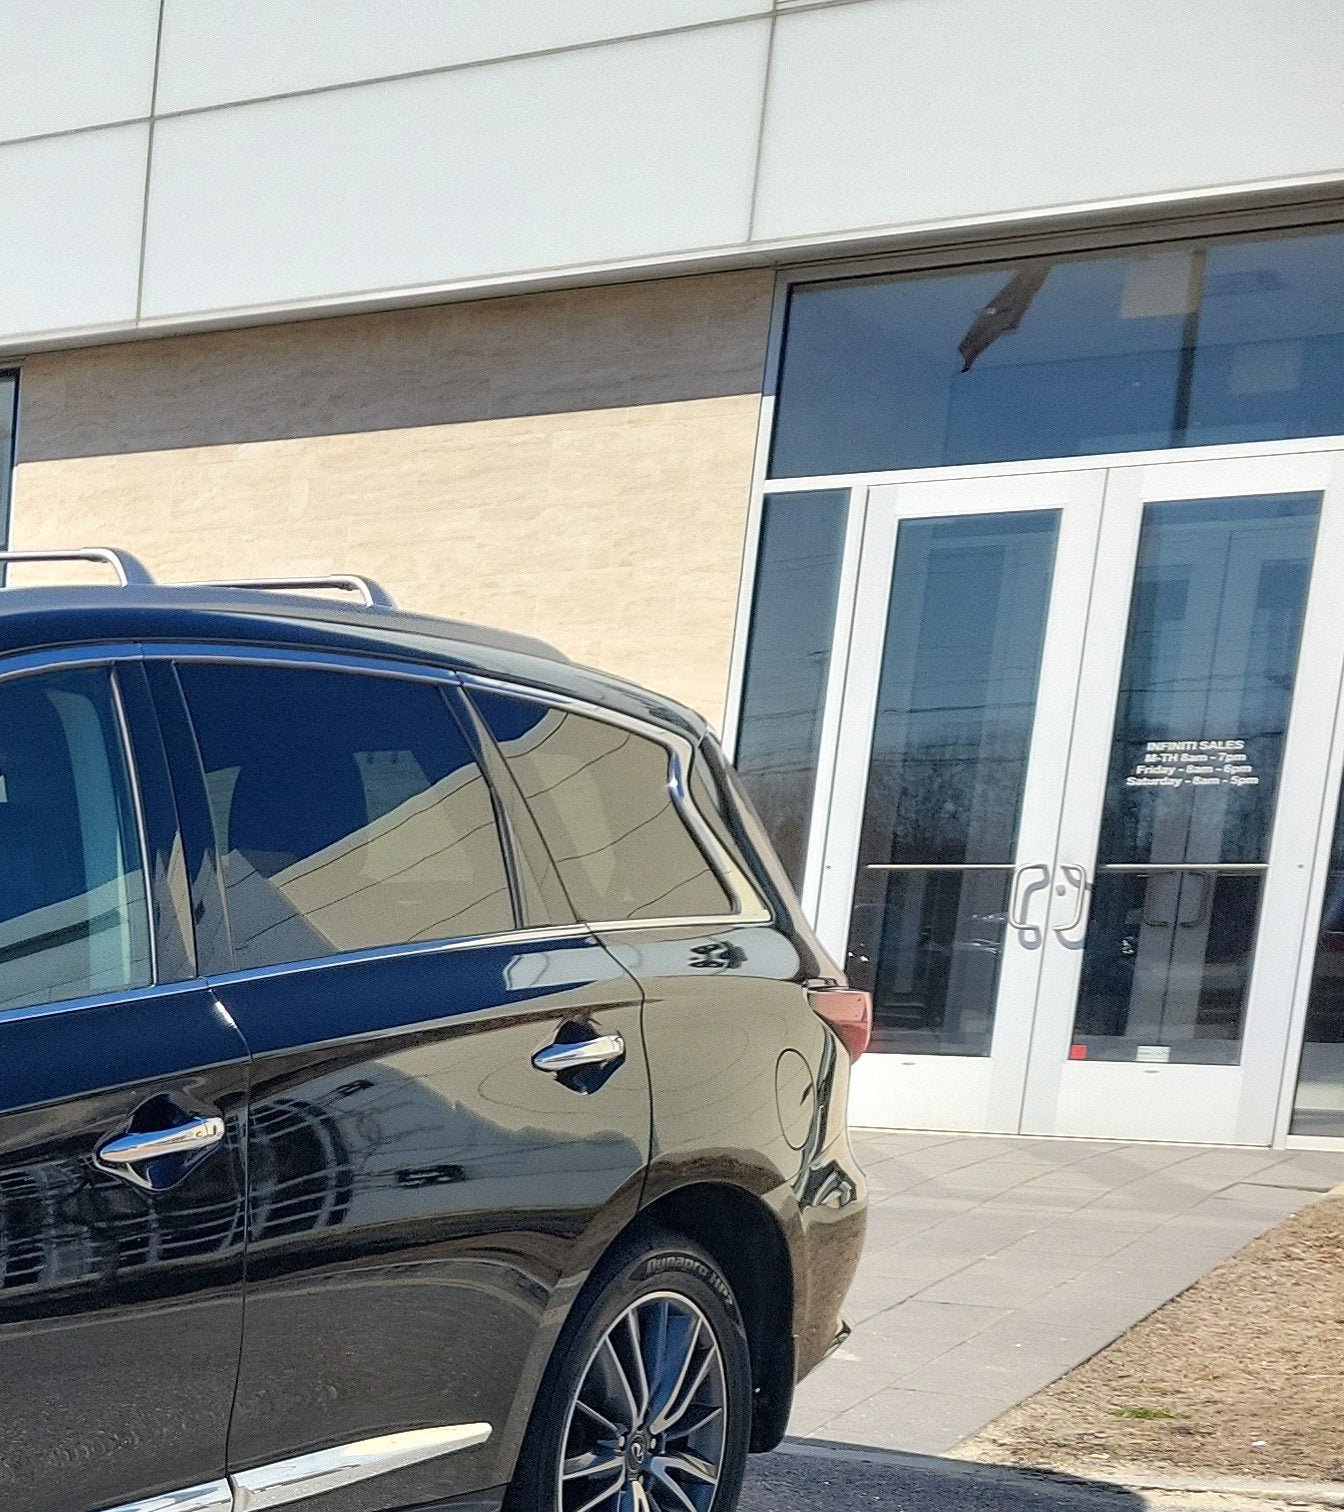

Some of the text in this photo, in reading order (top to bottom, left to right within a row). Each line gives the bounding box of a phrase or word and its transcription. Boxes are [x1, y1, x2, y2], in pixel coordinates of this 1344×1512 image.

[1146, 740, 1245, 751] INFINITI SALES
[1217, 752, 1247, 763] 7pm
[1135, 765, 1177, 776] Friday
[1125, 776, 1183, 788] Saturday
